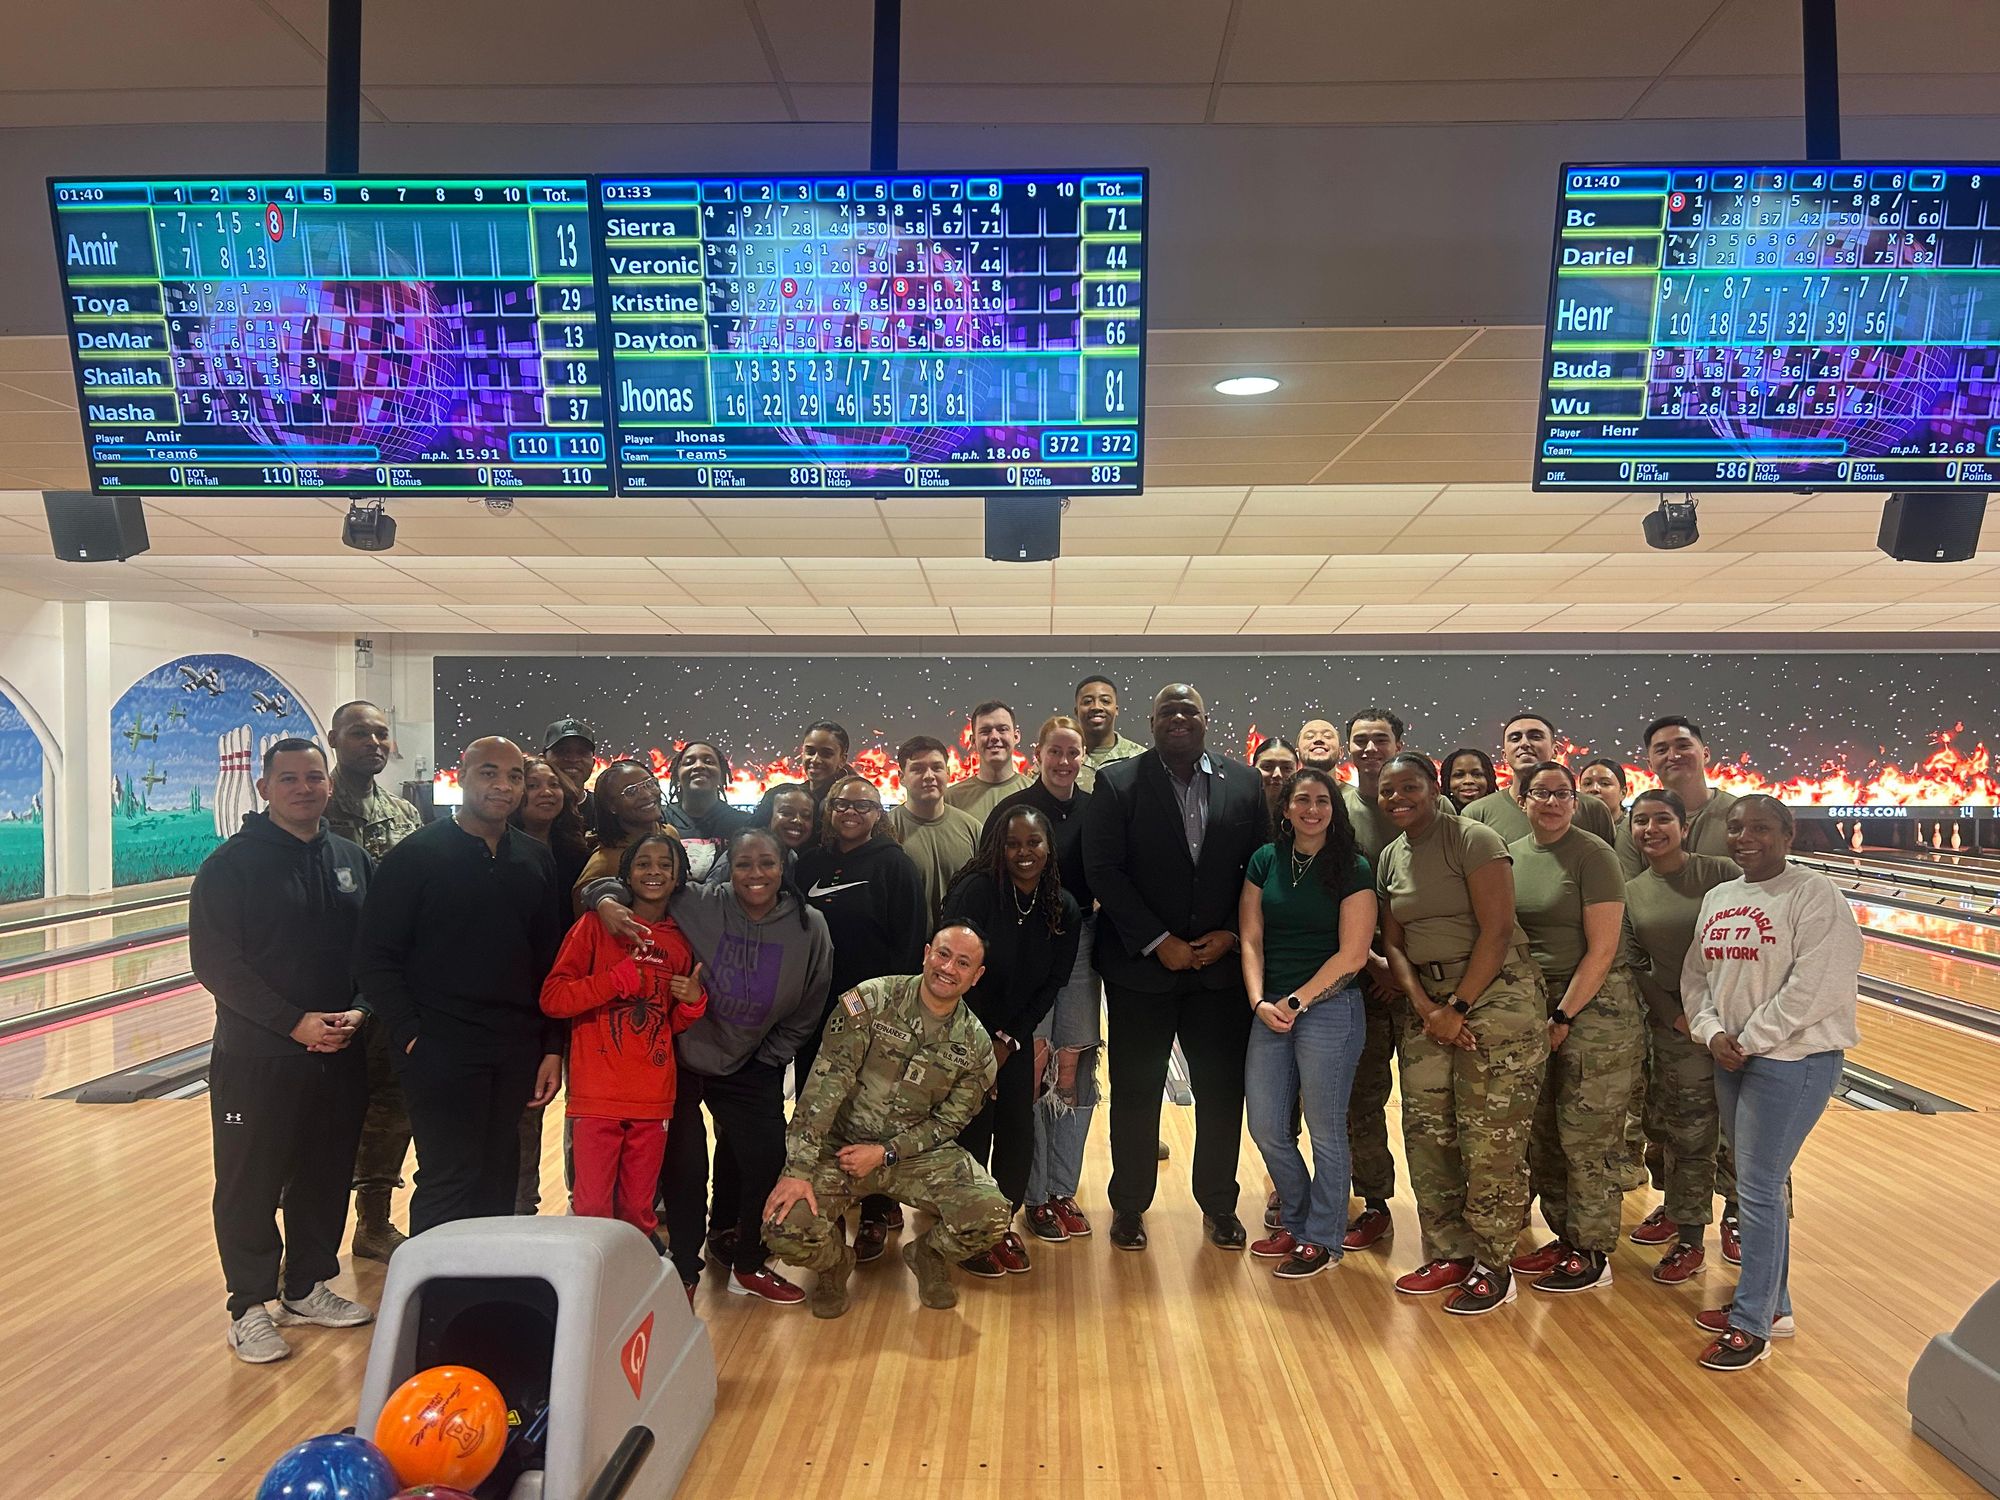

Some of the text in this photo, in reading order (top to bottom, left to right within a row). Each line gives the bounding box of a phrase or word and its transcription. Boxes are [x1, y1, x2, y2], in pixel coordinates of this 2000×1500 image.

[1572, 175, 1981, 189] 01:40 1 2 3 4 5 6 7 8
[59, 188, 570, 201] 01:40 1 2 3 4 5 6 7 8 9 10 Tot.
[606, 183, 1124, 200] 01:33 1 2 3 4 5 6 7 8 9 10 Tot.
[1107, 208, 1127, 230] 71
[1566, 209, 1596, 227] Bc
[606, 218, 676, 236] Sierra
[67, 232, 118, 265] Amir
[556, 223, 577, 268] 13
[1106, 246, 1127, 268] 44
[1563, 246, 1633, 265] Dariel
[610, 256, 699, 274] Veronic
[560, 288, 581, 311] 29
[612, 294, 698, 311] Kristine
[1096, 284, 1127, 306] 110
[72, 295, 130, 315] Toya
[1557, 298, 1886, 335] Henr 10 18 25 32 39 56
[78, 332, 152, 349] DeMar
[564, 325, 584, 348] 13
[1106, 322, 1126, 344] 66
[615, 332, 697, 352] Dayton
[84, 368, 162, 385] Shailah
[567, 362, 587, 384] 18
[1552, 360, 1611, 378] Buda
[619, 378, 965, 416] Jhonas 16 22 29 46 55 73 81
[1105, 369, 1124, 412] 81
[89, 404, 155, 421] Nasha
[569, 399, 589, 421] 37
[1551, 398, 1590, 414] Wu
[95, 431, 181, 444] Player Amir
[624, 431, 725, 445] Player Jhonas
[1550, 425, 1639, 438] Player Henr
[518, 437, 600, 454] 110 110
[1050, 435, 1131, 453] 372 372
[1548, 446, 1572, 455] Team
[1928, 442, 1976, 454] 12.68
[96, 449, 198, 460] Team Team6
[456, 449, 500, 460] 15.91
[625, 449, 727, 461] Team Team5
[987, 448, 1030, 459] 18.06
[186, 469, 206, 478] TOT.
[262, 468, 292, 483] 110
[299, 469, 319, 478] TOT.
[376, 468, 385, 484] 0
[391, 469, 412, 478] TOT.
[478, 468, 487, 484] 0
[493, 470, 514, 478] TOT.
[562, 468, 592, 484] 110
[713, 469, 734, 478] TOT.
[789, 468, 819, 484] 803
[827, 469, 847, 478] TOT.
[904, 468, 913, 484] 0
[920, 469, 940, 478] TOT.
[1006, 467, 1016, 483] 0
[1022, 469, 1043, 477] TOT.
[1091, 466, 1121, 482] 803
[1547, 462, 1630, 481] Diff. 0
[1636, 472, 1669, 481] Pin fall
[1637, 464, 1659, 473] TOT.
[1715, 462, 1747, 479] 586
[1755, 464, 1777, 473] TOT.
[1837, 462, 1848, 479] 0
[1853, 472, 1885, 481] Bonus
[1854, 464, 1876, 473] TOT.
[1946, 462, 1957, 478] 0
[1963, 464, 1985, 473] TOT.
[102, 468, 179, 486] Diff. 0
[187, 477, 218, 486] Pin fall
[300, 477, 323, 487] Hdcp
[392, 477, 422, 486] Bonus
[494, 477, 523, 487] Points
[628, 468, 707, 486] Diff. 0
[714, 478, 745, 486] Pin fall
[827, 478, 851, 487] Hdcp
[920, 477, 950, 486] Bonus
[1022, 477, 1051, 486] Points
[1755, 472, 1780, 482] Hdcp
[1962, 472, 1993, 482] Points
[1828, 806, 1907, 817] 86FSS.COM
[1959, 806, 1974, 818] 14
[1709, 927, 1751, 940] EST 77
[1748, 907, 1776, 945] EAGLE
[721, 941, 759, 971] GOD
[1704, 947, 1759, 961] NEW YORK
[873, 1022, 907, 1041] HERNANDEZ
[942, 1052, 970, 1068] U.S. ARMY
